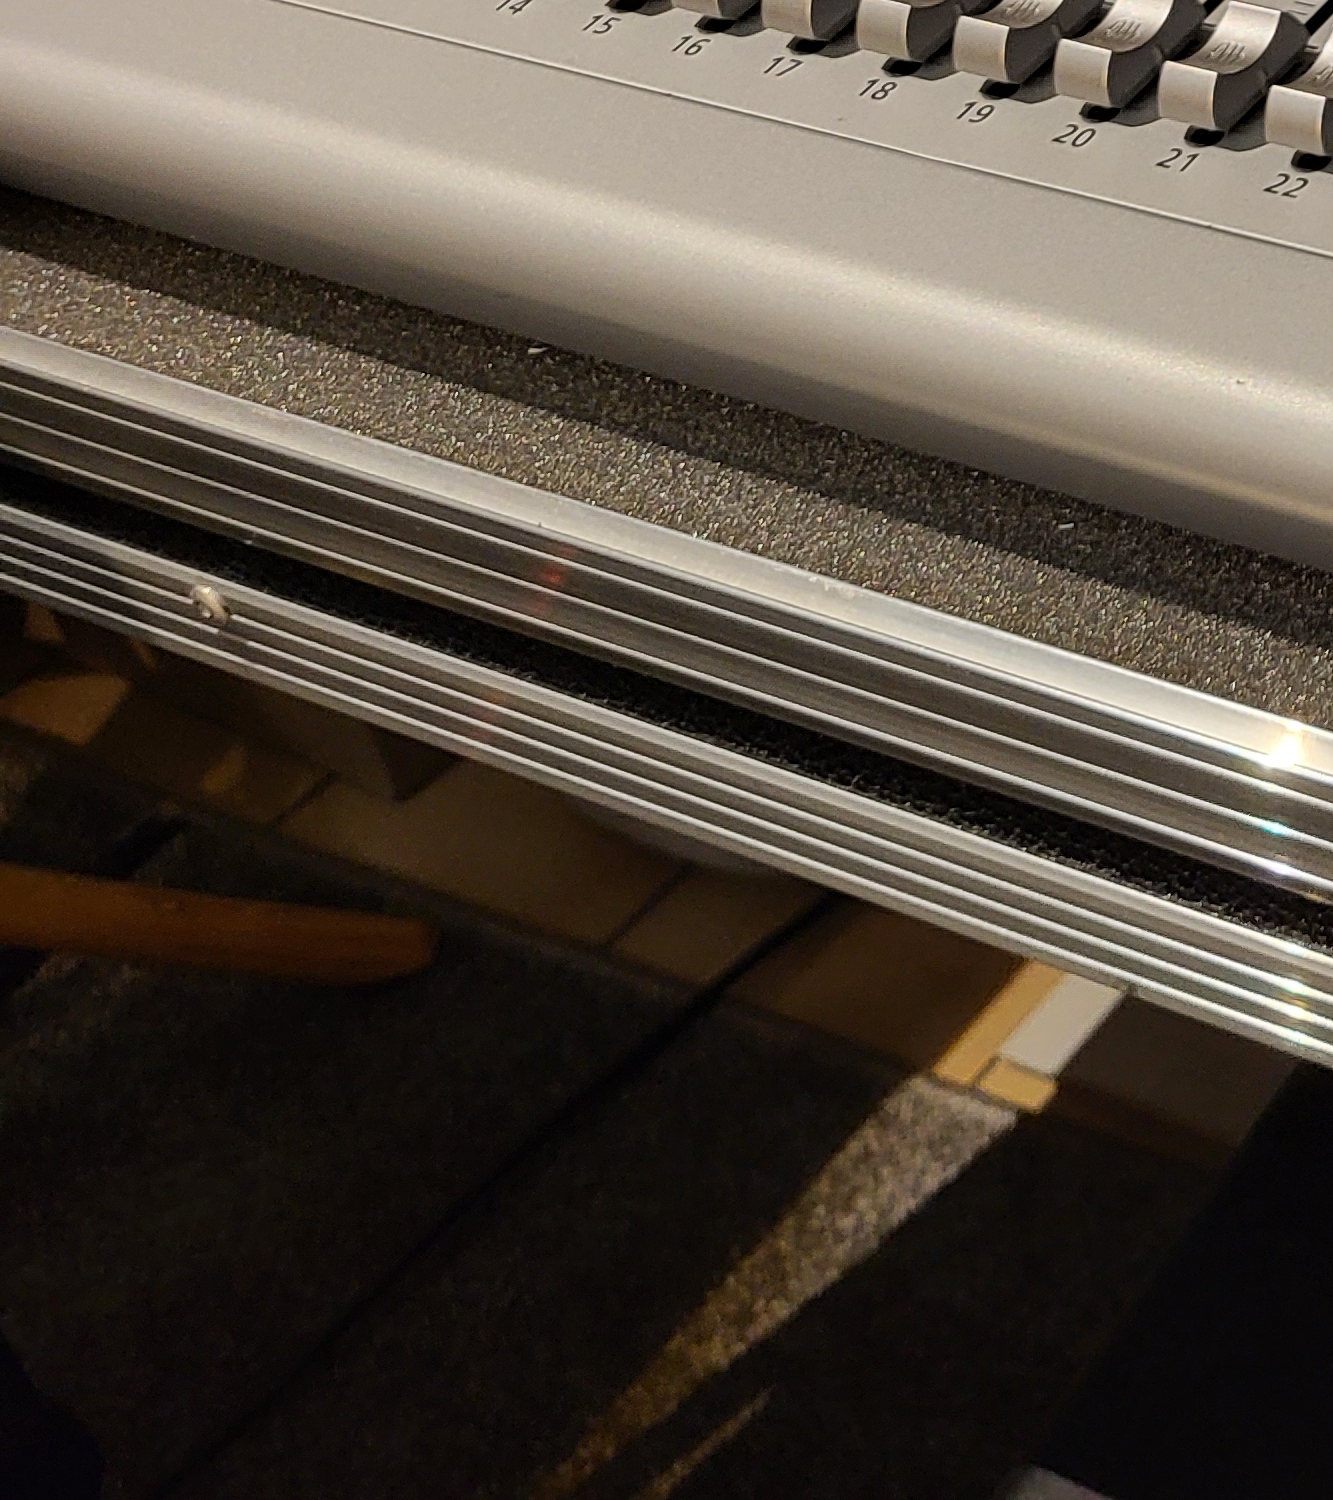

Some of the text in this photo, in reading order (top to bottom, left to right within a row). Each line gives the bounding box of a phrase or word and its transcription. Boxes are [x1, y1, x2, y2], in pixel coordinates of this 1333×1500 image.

[582, 14, 622, 35] 15
[671, 34, 712, 56] 16
[763, 56, 804, 77] 17
[858, 78, 898, 101] 18
[956, 101, 996, 124] 19
[1051, 123, 1097, 148] 20
[1155, 147, 1200, 173] 21
[1262, 172, 1310, 199] 22
